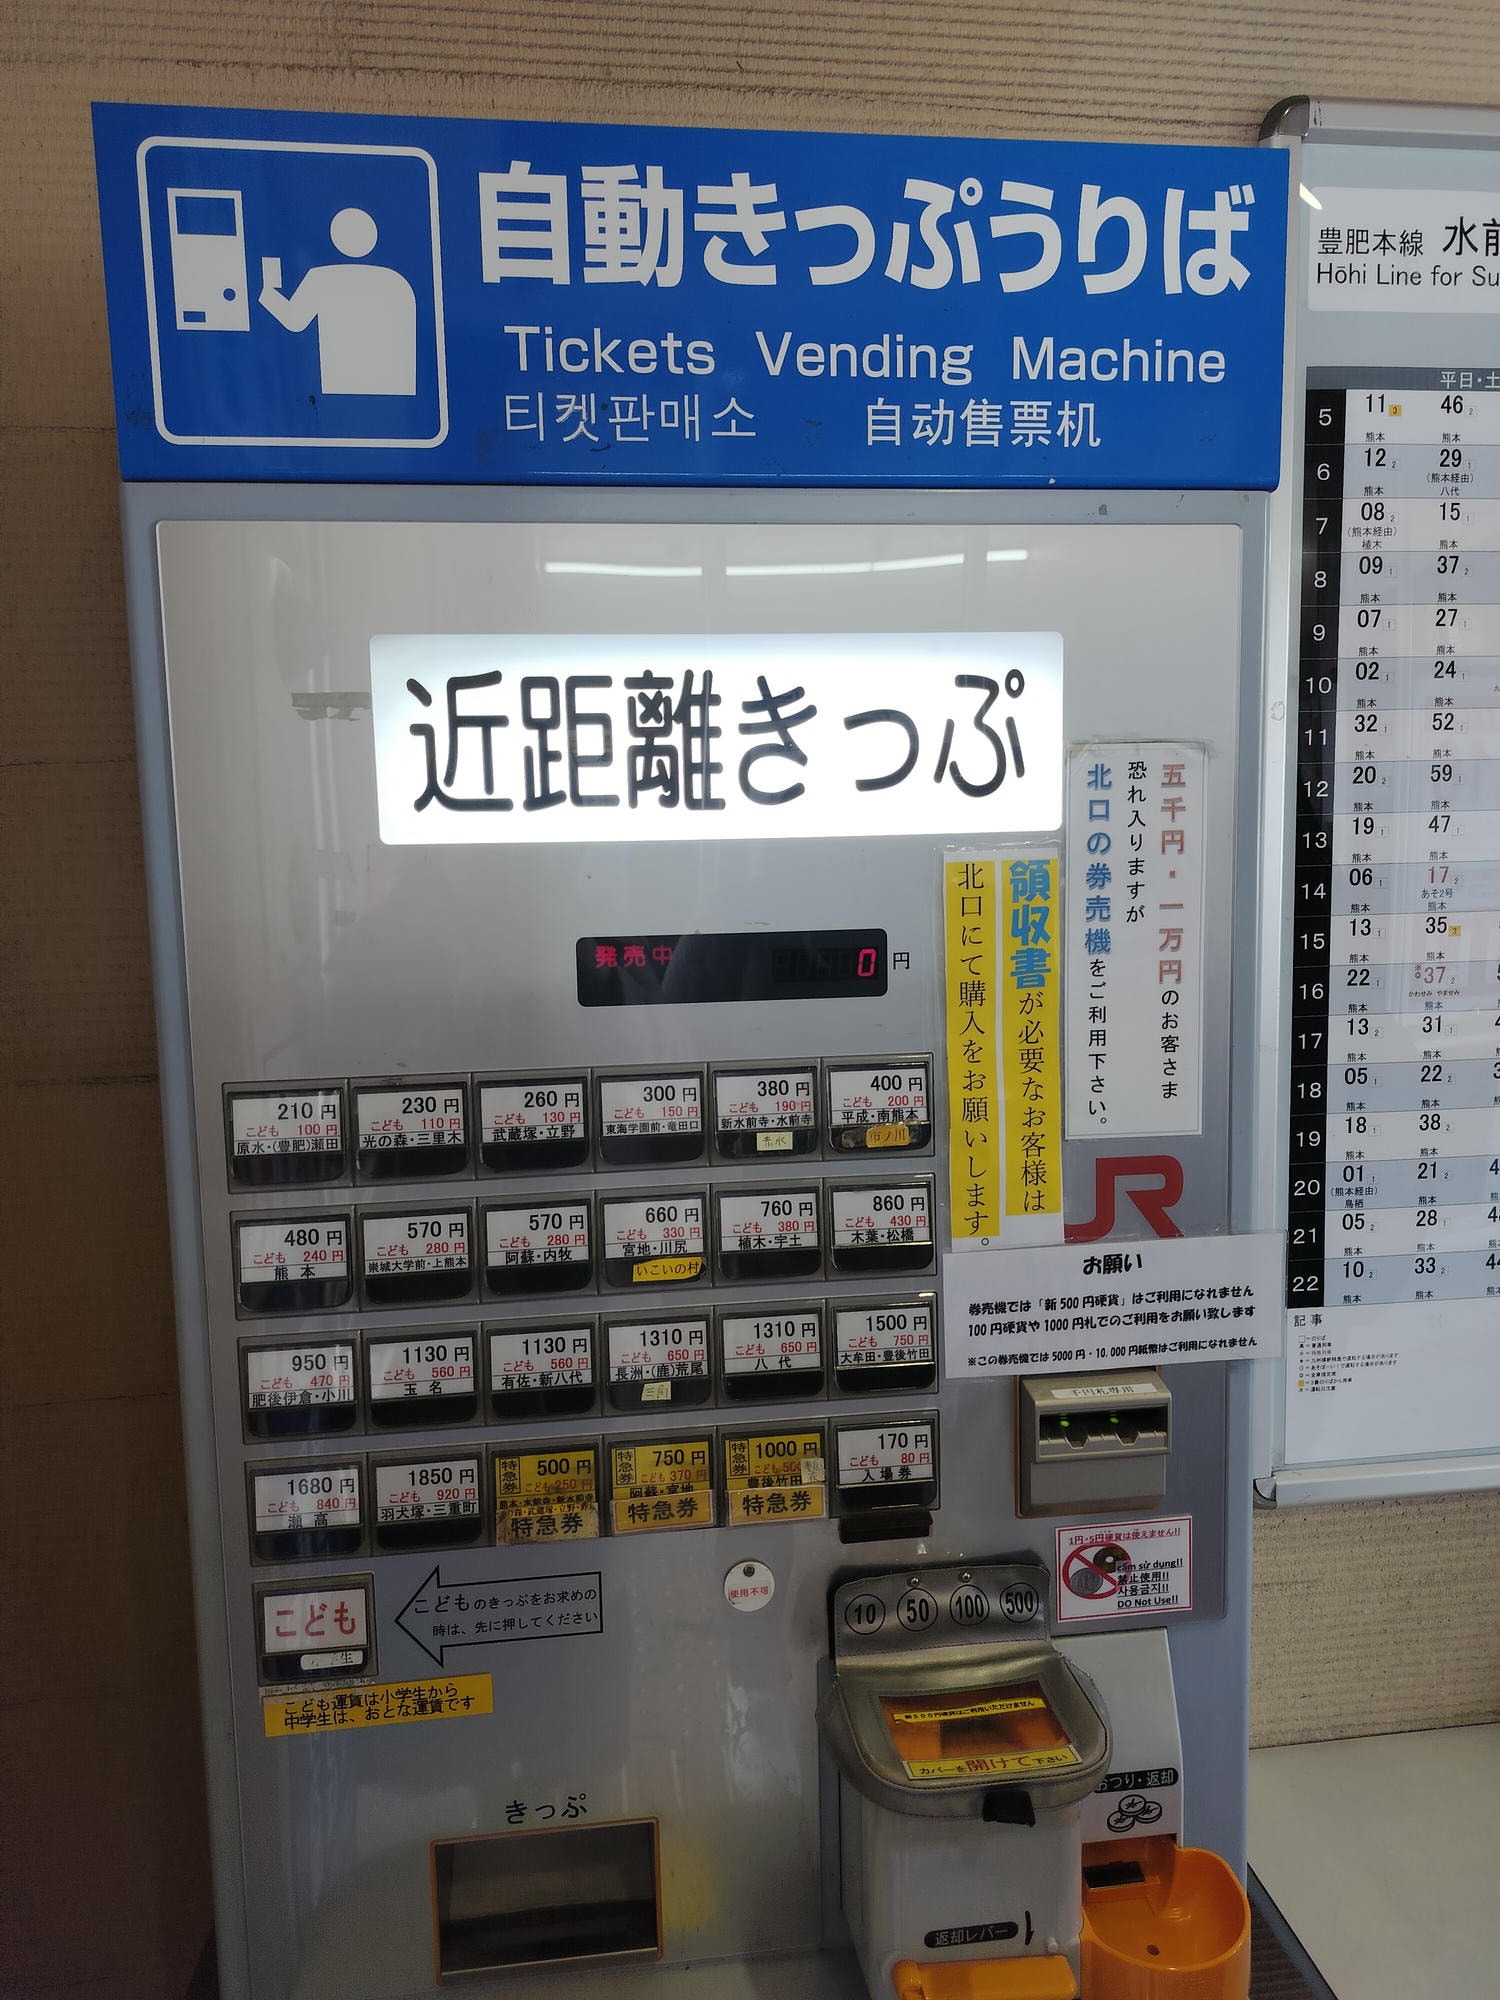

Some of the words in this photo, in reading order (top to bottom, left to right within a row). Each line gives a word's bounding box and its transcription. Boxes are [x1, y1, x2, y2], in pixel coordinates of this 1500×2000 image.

[478, 160, 1256, 296] 自動きっぷうりば
[1318, 226, 1424, 257] 豊肥本線
[1376, 262, 1422, 286] Line
[1430, 264, 1464, 286] for
[504, 324, 716, 376] Tickets
[754, 330, 974, 386] Vending
[1010, 336, 1226, 384] Machine
[504, 392, 758, 442] 티켓판매소
[866, 396, 1102, 450] 自动售票机
[1318, 408, 1332, 426] 5
[1366, 394, 1385, 413] 11
[1440, 395, 1464, 414] 46
[1365, 432, 1386, 443] 熊本
[1441, 432, 1461, 443] 熊本
[1316, 463, 1331, 481] 6
[1364, 448, 1387, 467] 12
[1439, 449, 1462, 468] 29
[1440, 486, 1460, 497] 八代
[1315, 517, 1329, 535] 7
[1360, 502, 1385, 521] 08
[1439, 503, 1461, 521] 15
[1361, 539, 1382, 550] 植木
[1314, 570, 1328, 588] 8
[1358, 556, 1383, 575] 09
[1437, 556, 1459, 574] 37
[1313, 624, 1326, 641] 9
[1357, 609, 1381, 628] 07
[1306, 677, 1332, 695] 10
[1433, 661, 1456, 679] 24
[406, 668, 1026, 813] 近距離きっぷ
[1304, 729, 1327, 746] 11
[1354, 714, 1378, 733] 32
[1303, 780, 1329, 798] 12
[1352, 766, 1376, 784] 20
[1430, 765, 1453, 783] 59
[1125, 760, 1148, 924] 恐れ入りますが
[1302, 832, 1327, 849] 13
[1428, 815, 1451, 833] 47
[1301, 883, 1326, 900] 14
[1349, 868, 1373, 886] 06
[1428, 866, 1449, 884] 17
[1350, 903, 1370, 914] 熊本
[1084, 764, 1113, 1124] 北口の券売機をご利用下さい。
[1300, 933, 1325, 950] 15
[1425, 916, 1448, 934] 35
[594, 944, 674, 968] 発売中
[856, 948, 877, 977] 0
[892, 951, 910, 971] 円
[1299, 984, 1324, 1000] 16
[1347, 969, 1370, 987] 22
[1424, 966, 1446, 984] 37
[1008, 860, 1053, 1214] 領収書が必要なお客様は
[1298, 1033, 1323, 1050] 17
[1422, 1016, 1442, 1033] 31
[956, 862, 992, 1246] 北口にて購入をお願いします。
[1297, 1082, 1322, 1099] 18
[1344, 1067, 1368, 1085] 05
[841, 1108, 919, 1124] 平成・南熊本
[842, 1096, 873, 1108] こども
[245, 1125, 279, 1138] こども
[492, 1125, 576, 1142] 武蔵塚・立野
[721, 1113, 813, 1130] 新水前寺・水前寺
[1296, 1131, 1321, 1147] 19
[1419, 1113, 1441, 1131] 38
[362, 1131, 462, 1149] 光の森・三里木
[1293, 1179, 1320, 1197] 20
[1343, 1165, 1364, 1183] 01
[1064, 1154, 1186, 1244] JR
[851, 1228, 915, 1244] 木葉・松橋
[1293, 1228, 1317, 1245] 21
[1416, 1210, 1438, 1227] 28
[622, 1240, 688, 1257] 宮地・川尻
[738, 1234, 803, 1250] 植木・宇土
[505, 1248, 573, 1265] 阿蘇・内牧
[637, 1261, 700, 1277] いこいの村
[1082, 1253, 1143, 1276] お願い
[274, 1265, 316, 1281] 熊本
[1292, 1276, 1319, 1292] 22
[1343, 1261, 1364, 1279] 10
[1414, 1258, 1436, 1274] 33
[754, 1356, 792, 1371] 八代
[840, 1347, 930, 1365] 大牟田・豊後竹田
[403, 1380, 442, 1397] 玉名
[501, 1372, 583, 1389] 有佐・新八代
[252, 1388, 350, 1408] 肥後伊倉・小川
[849, 1454, 879, 1467] こども
[862, 1466, 912, 1482] 入場券
[287, 1511, 329, 1528] 瀬高
[380, 1503, 476, 1521] 羽犬塚・三重町
[510, 1511, 584, 1537] 特急券
[627, 1504, 699, 1524] 特急券
[414, 1587, 598, 1615] こどものきっぷをお求めの
[729, 1586, 769, 1600] 使用不可
[1117, 1600, 1132, 1608] DO
[1134, 1598, 1152, 1607] Not
[274, 1600, 357, 1639] こども
[854, 1604, 876, 1625] 10
[906, 1598, 930, 1623] 50
[954, 1594, 985, 1619] 100
[1004, 1590, 1035, 1615] 500
[432, 1610, 599, 1638] 時は、先に押してください
[284, 1682, 459, 1716] こども運賃は小学生から
[919, 1754, 1068, 1775] カバーを開けて下さい
[504, 1792, 588, 1825] きっぷ
[934, 1926, 1009, 1946] 返却レバー
